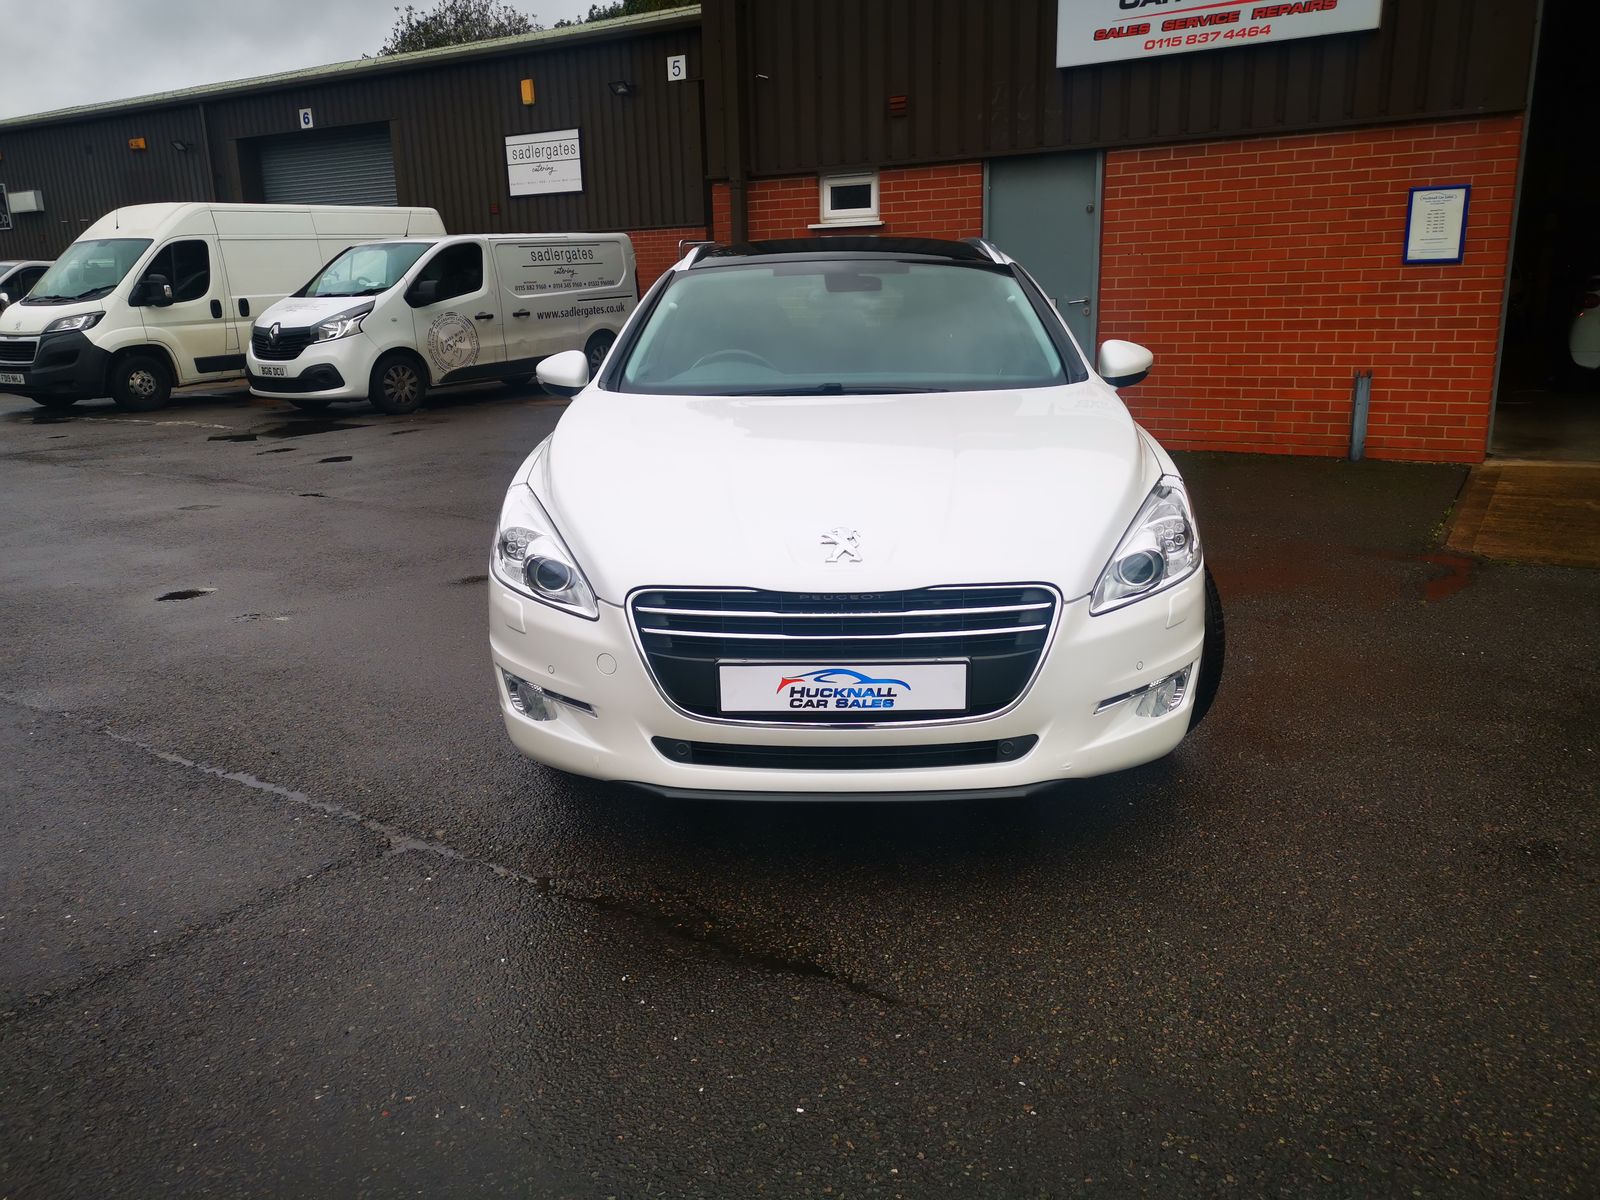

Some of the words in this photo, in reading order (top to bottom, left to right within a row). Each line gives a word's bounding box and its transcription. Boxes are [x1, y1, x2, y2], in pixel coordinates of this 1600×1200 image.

[1094, 23, 1150, 41] SALES
[1161, 10, 1240, 32] SERVICE
[1251, 0, 1338, 20] REPAIRS
[1144, 37, 1182, 50] 0115
[1185, 31, 1222, 45] 837
[1223, 24, 1272, 40] 4464
[672, 60, 681, 77] 5
[303, 111, 310, 126] 6
[512, 143, 576, 160] sadlergates
[531, 164, 557, 176] catering
[530, 248, 594, 263] sadlergates
[537, 302, 625, 319] www.sadlergates.co.uk
[789, 686, 897, 698] HUCKNALL
[789, 698, 828, 708] CAR
[835, 698, 894, 708] SALES
